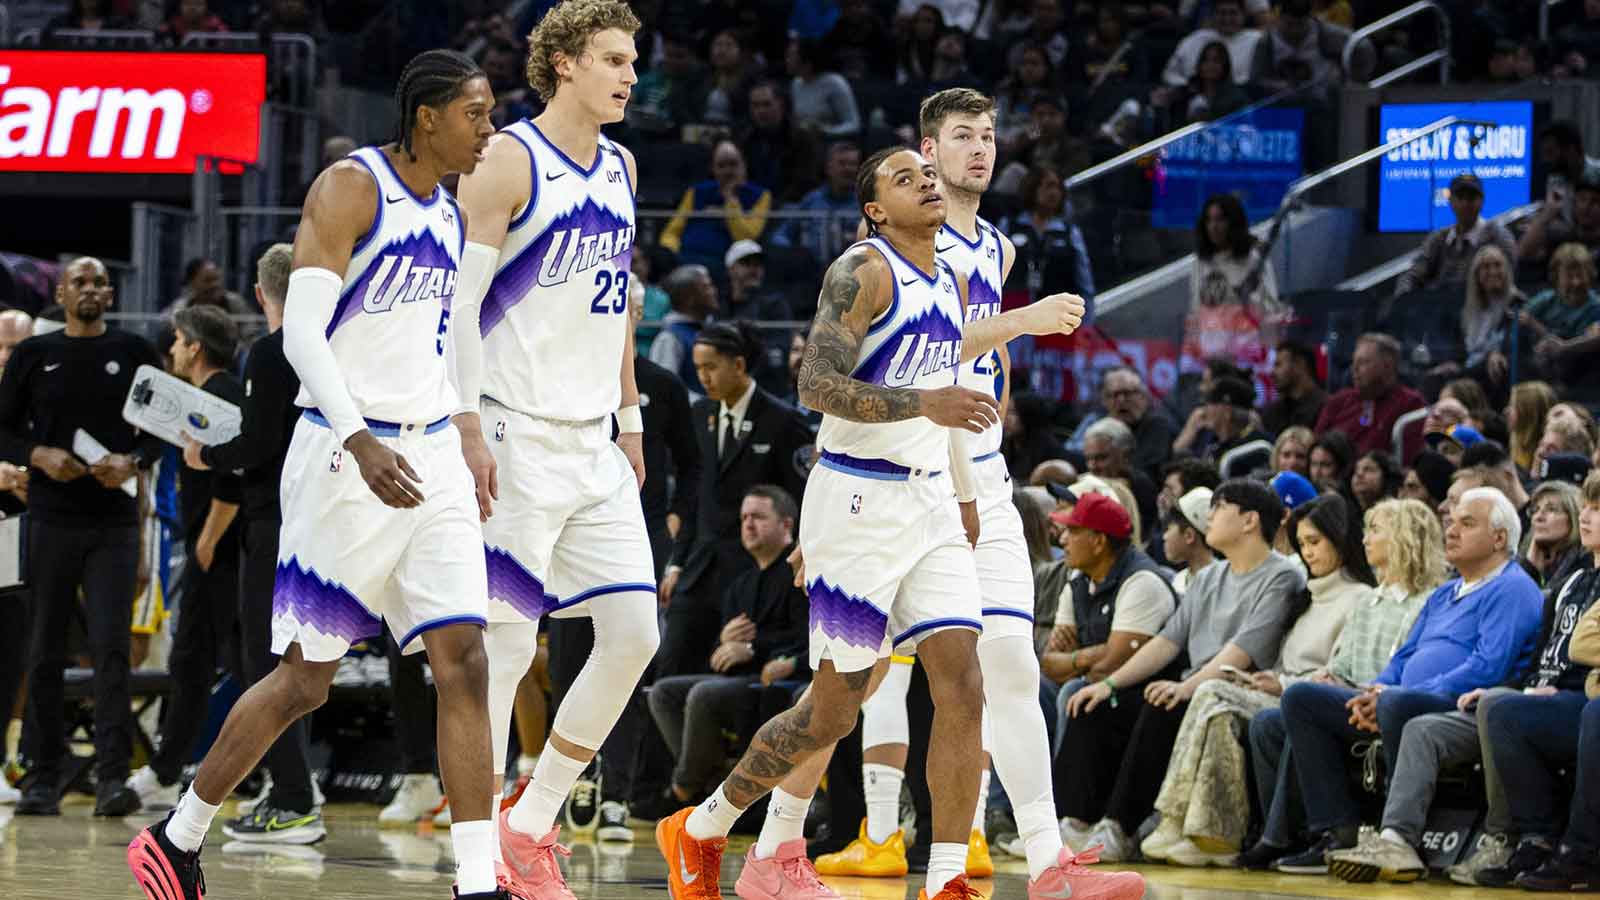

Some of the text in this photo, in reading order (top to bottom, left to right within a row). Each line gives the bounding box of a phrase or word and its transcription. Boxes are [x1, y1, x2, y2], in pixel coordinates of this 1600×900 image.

[0, 66, 187, 159] arm
[362, 254, 459, 314] UTAH
[537, 225, 634, 288] UTAH
[590, 269, 629, 314] 23
[436, 308, 450, 357] 5
